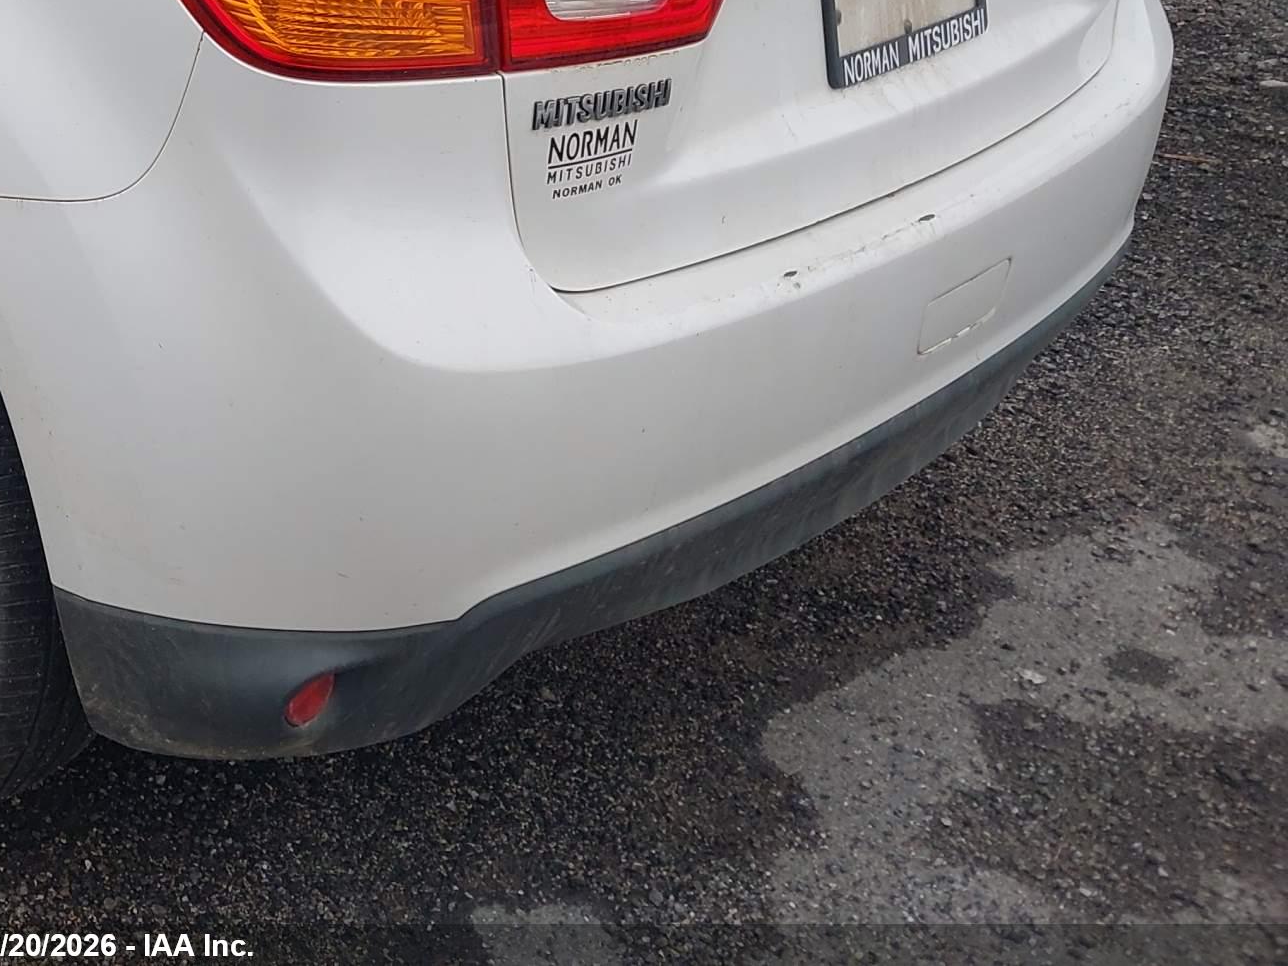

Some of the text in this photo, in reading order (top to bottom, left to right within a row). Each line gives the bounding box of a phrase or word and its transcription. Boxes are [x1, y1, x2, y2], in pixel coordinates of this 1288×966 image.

[843, 8, 986, 85] NORMAN MITSUBISHI
[532, 78, 672, 130] MITSUBISHI
[548, 119, 638, 164] NORMAN
[546, 153, 632, 184] MITSUBISHI
[552, 174, 623, 199] NORMAN OK
